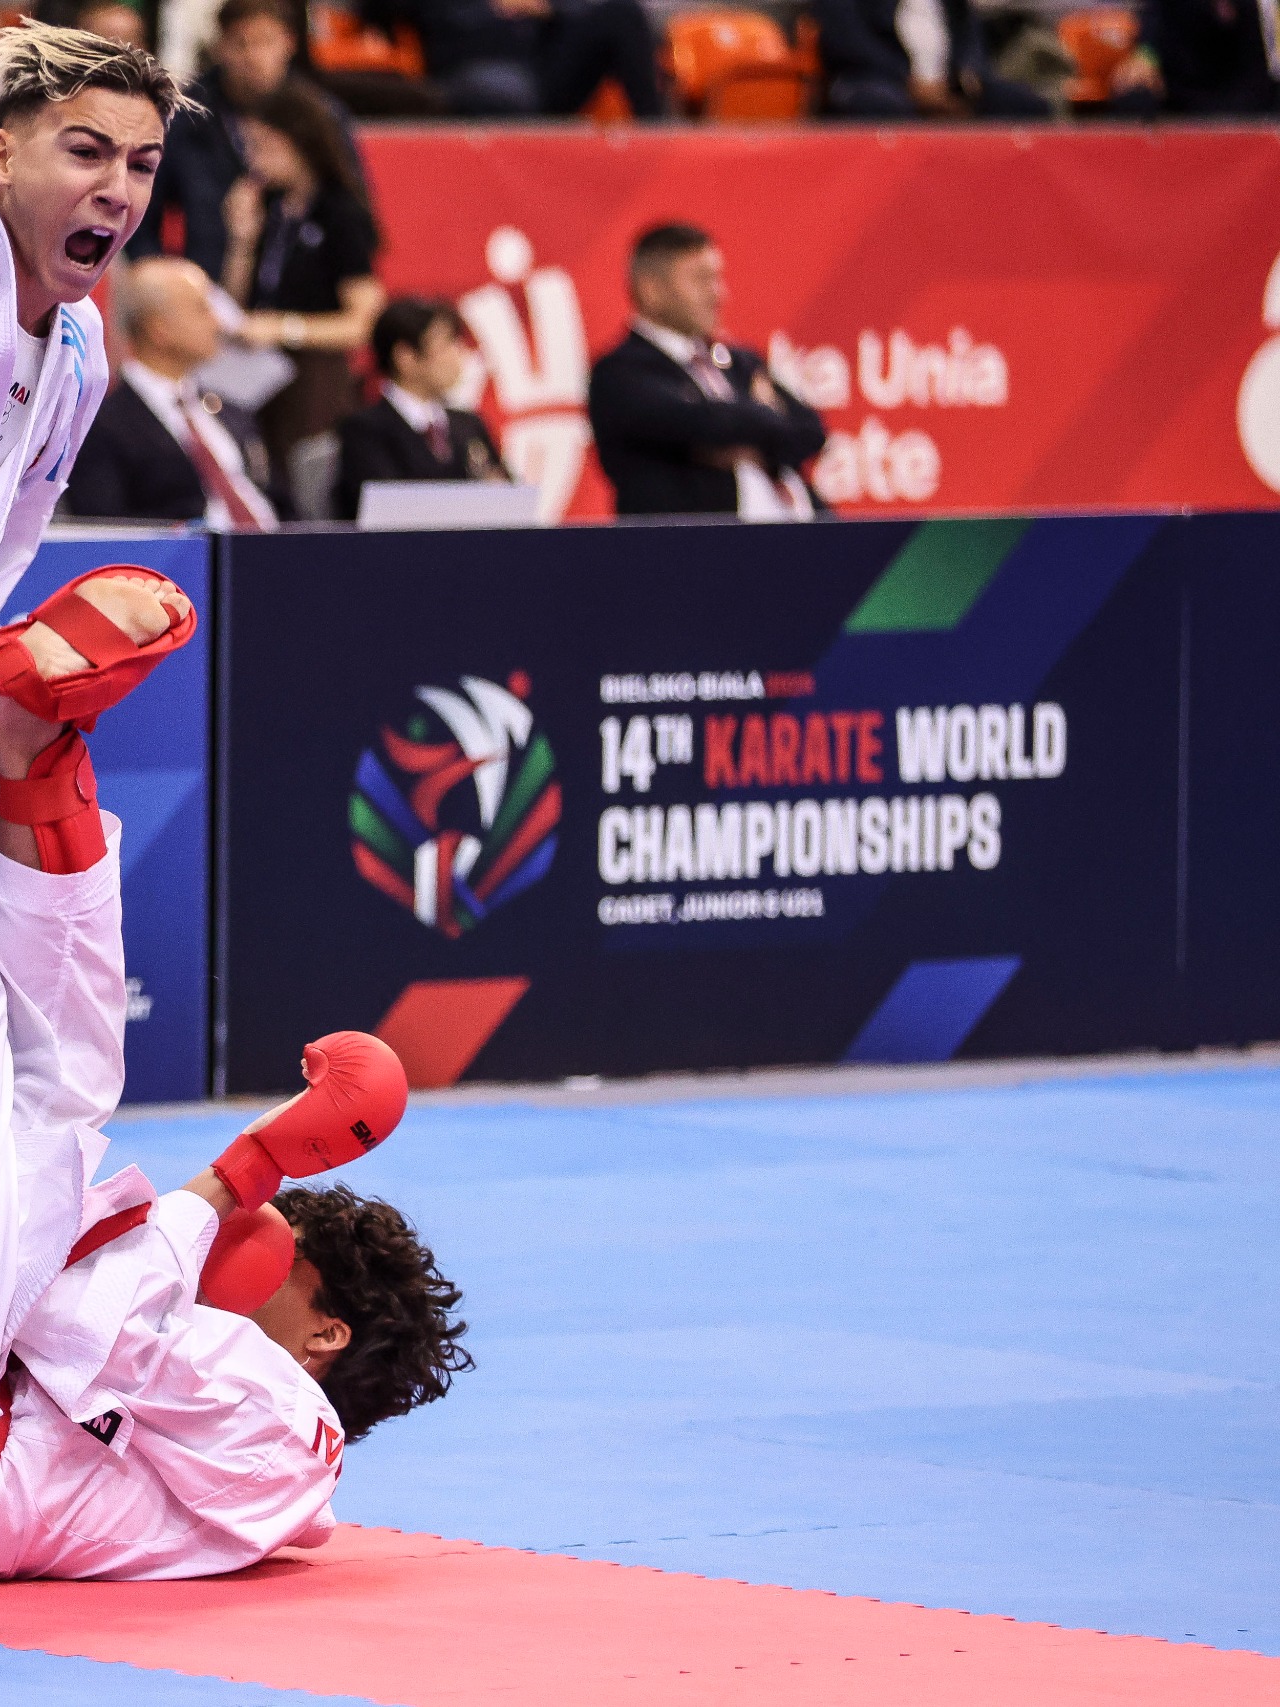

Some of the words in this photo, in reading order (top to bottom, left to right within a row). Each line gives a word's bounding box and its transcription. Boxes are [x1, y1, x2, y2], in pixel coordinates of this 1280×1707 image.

[857, 325, 1008, 409] Unia
[600, 713, 694, 793] 14TH
[703, 710, 884, 789] KARATE
[895, 702, 1067, 783] WORLD
[598, 791, 1001, 884] CHAMPIONSHIPS
